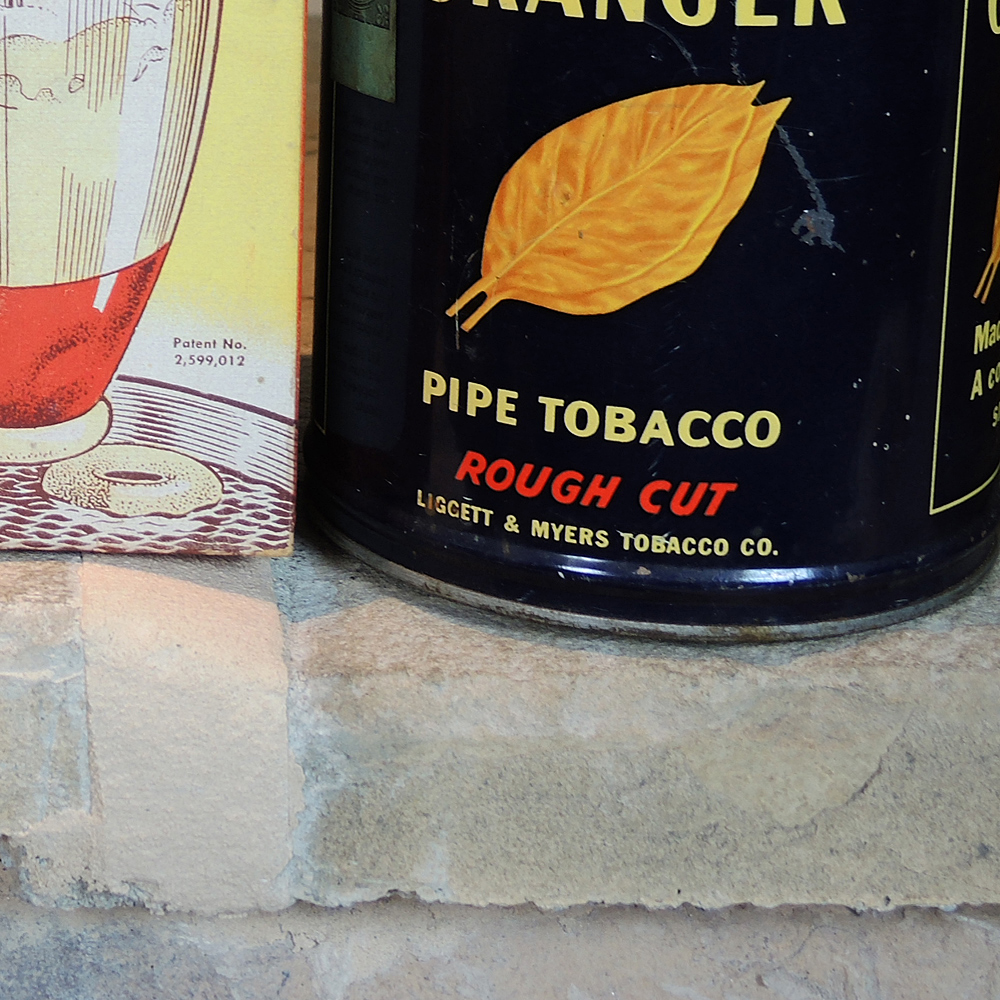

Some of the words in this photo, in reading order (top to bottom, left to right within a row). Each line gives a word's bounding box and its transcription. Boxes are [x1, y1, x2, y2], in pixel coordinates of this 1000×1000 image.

[173, 337, 217, 349] Patent
[223, 338, 247, 350] No.
[174, 354, 246, 368] 2,599,012
[422, 369, 518, 426] PIPE
[537, 395, 781, 449] TOBACCO
[970, 369, 983, 401] A
[454, 450, 621, 509] ROUGH
[639, 480, 739, 517] CUT
[416, 489, 494, 527] LIGGETT
[503, 514, 520, 534] &
[531, 519, 610, 548] MYERS
[621, 532, 729, 556] TOBACCO
[740, 537, 779, 556] CO.
